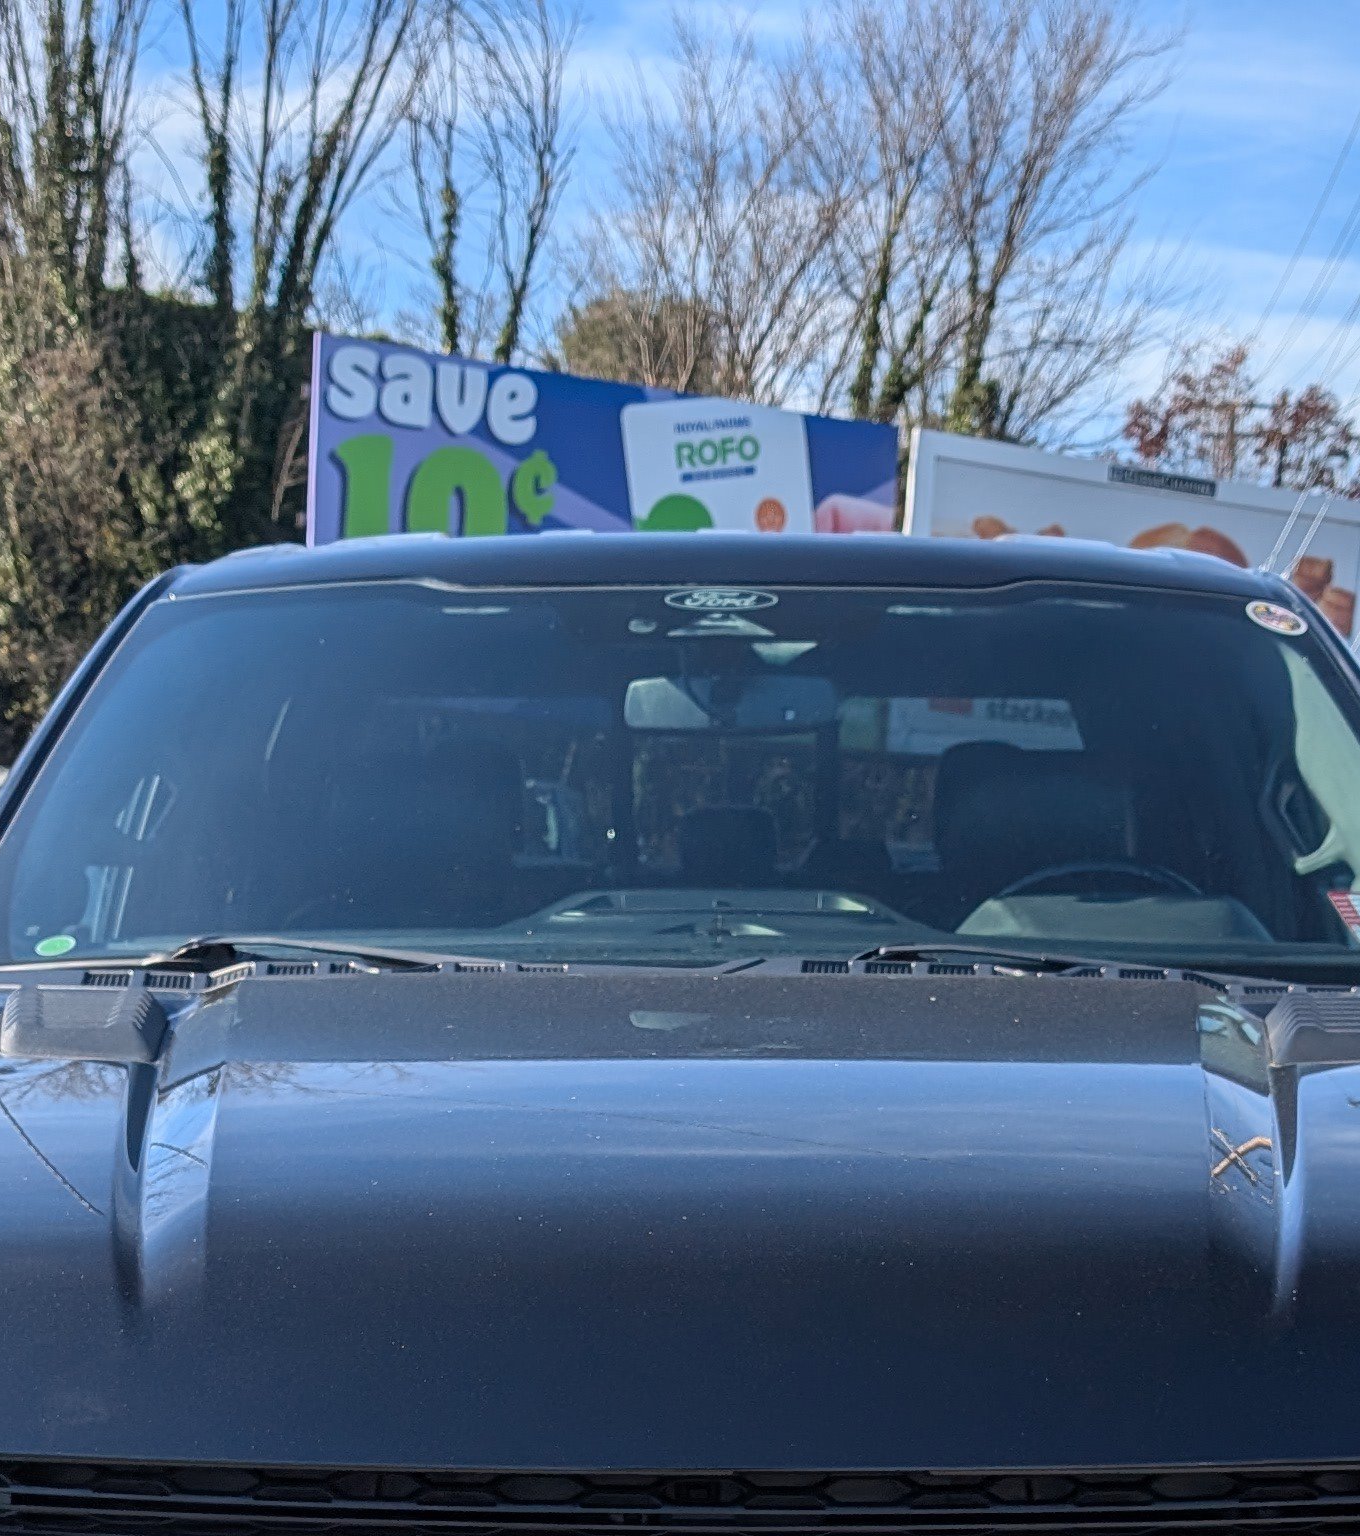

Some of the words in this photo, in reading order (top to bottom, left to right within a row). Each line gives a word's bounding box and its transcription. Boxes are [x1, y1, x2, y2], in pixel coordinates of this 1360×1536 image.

[327, 346, 538, 445] save
[674, 435, 761, 468] ROFO
[683, 589, 758, 607] Ford
